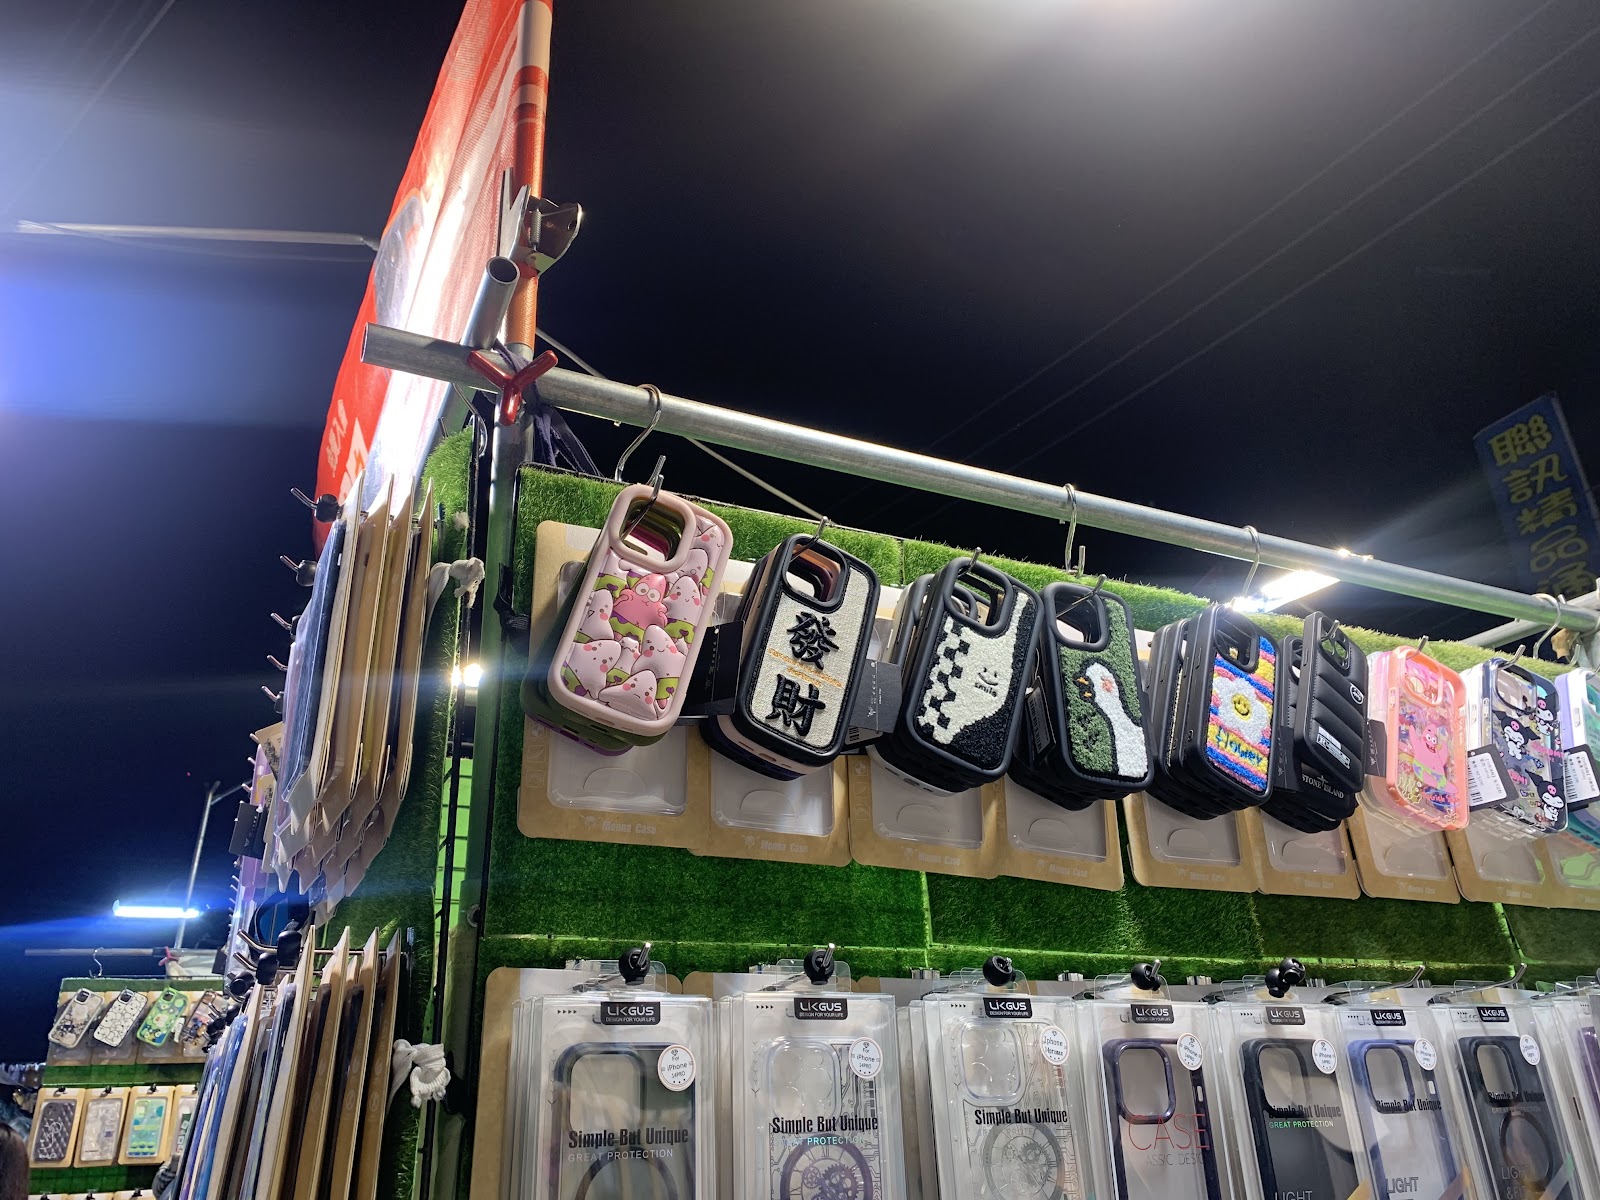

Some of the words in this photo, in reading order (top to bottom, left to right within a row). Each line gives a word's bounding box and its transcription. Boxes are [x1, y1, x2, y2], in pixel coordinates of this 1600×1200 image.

[765, 611, 840, 737] 發財
[1302, 773, 1321, 789] STONE
[1323, 784, 1344, 799] ISLAND
[635, 823, 657, 835] Case
[789, 843, 809, 853] Case
[667, 1062, 688, 1072] iPhone
[1313, 1104, 1342, 1119] Unique
[1417, 1099, 1442, 1112] Unique
[772, 1116, 813, 1134] Simple
[817, 1116, 837, 1132] But
[840, 1115, 878, 1132] Unique
[974, 1109, 1011, 1126] Simple
[1014, 1108, 1031, 1124] But
[1034, 1108, 1068, 1124] Unique
[1268, 1121, 1291, 1129] GREAT
[1292, 1120, 1334, 1128] PROTECTION
[568, 1129, 615, 1150] Simple
[619, 1128, 641, 1146] But
[645, 1127, 689, 1148] Unique
[1128, 1113, 1210, 1151] CASE
[568, 1152, 603, 1163] GREAT
[607, 1149, 673, 1161] PROTECTION
[1385, 1176, 1419, 1194] LIGHT
